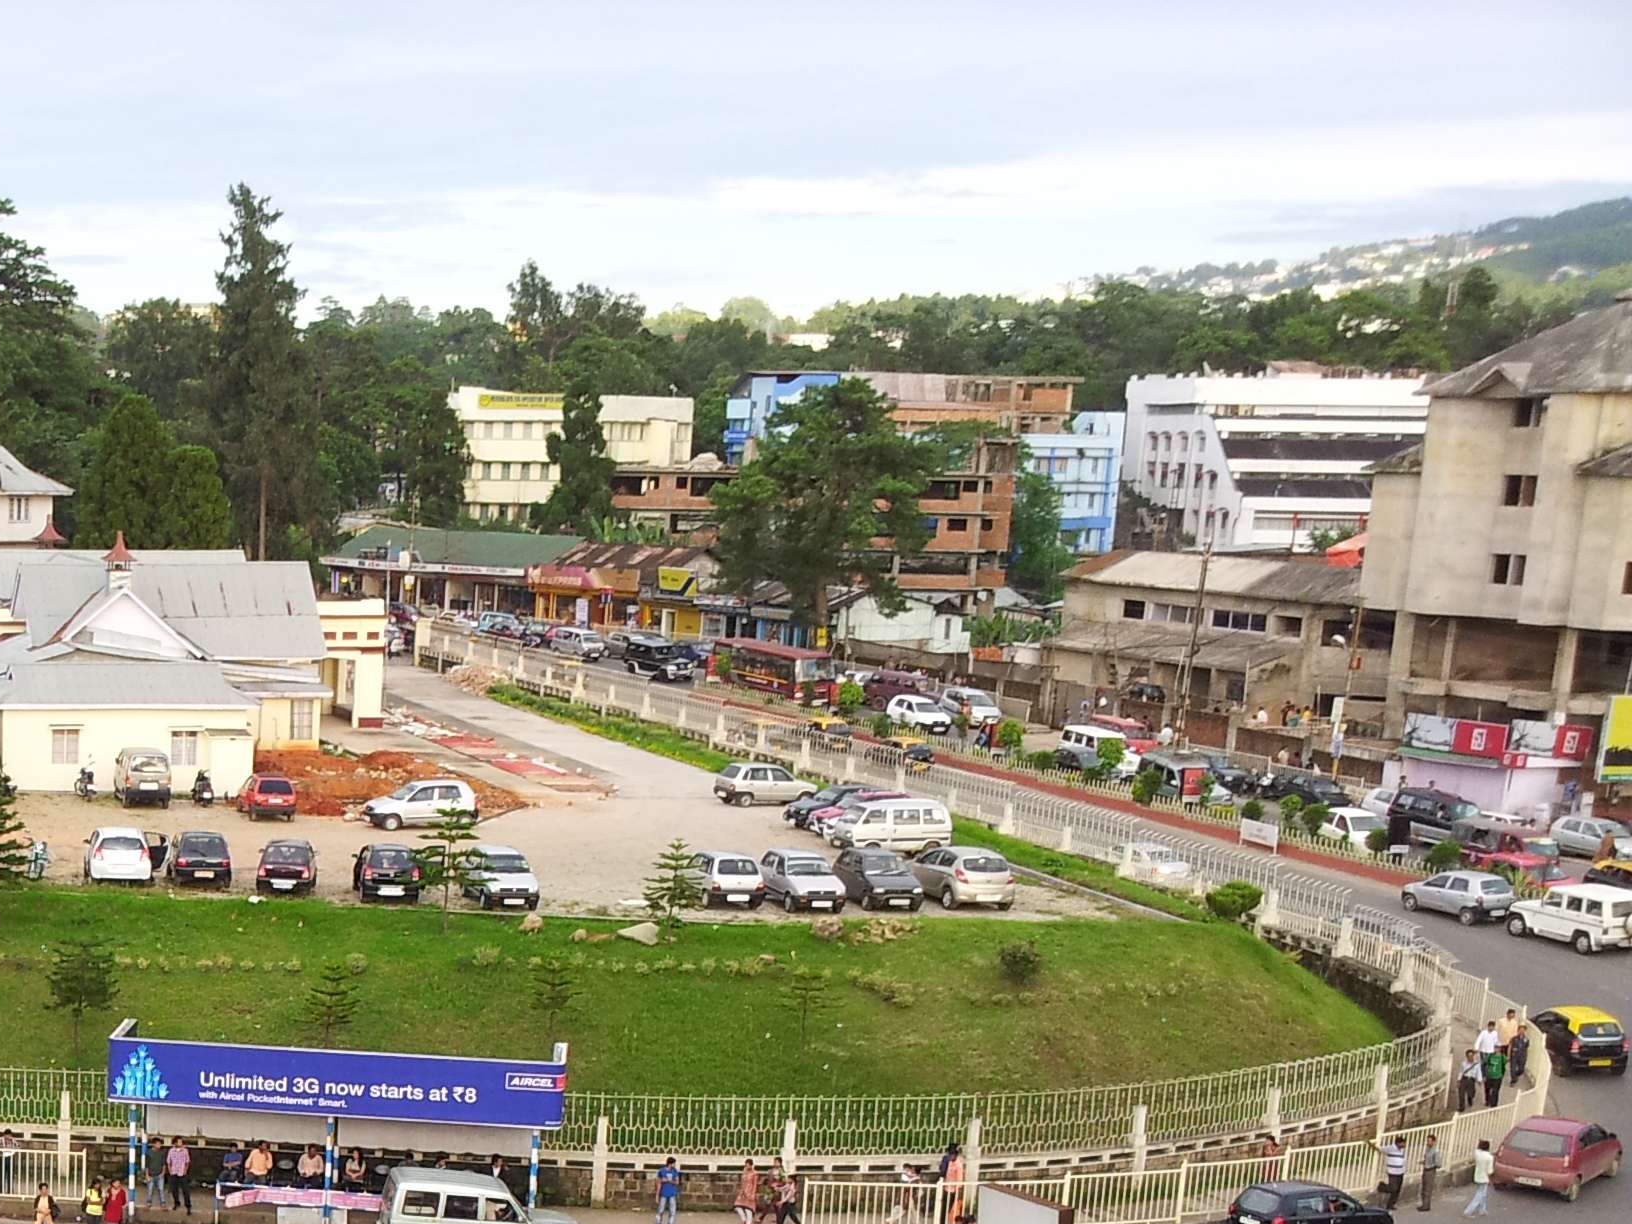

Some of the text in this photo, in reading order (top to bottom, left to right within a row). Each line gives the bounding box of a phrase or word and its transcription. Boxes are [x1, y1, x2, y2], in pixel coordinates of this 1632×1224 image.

[199, 1071, 288, 1093] Unlimited
[292, 1077, 320, 1095] 3G
[324, 1082, 366, 1097] now
[369, 1082, 424, 1101] starts
[428, 1087, 448, 1102] at
[510, 1076, 555, 1088] AIRCEL
[198, 1090, 218, 1100] with
[219, 1091, 245, 1101] Aircel
